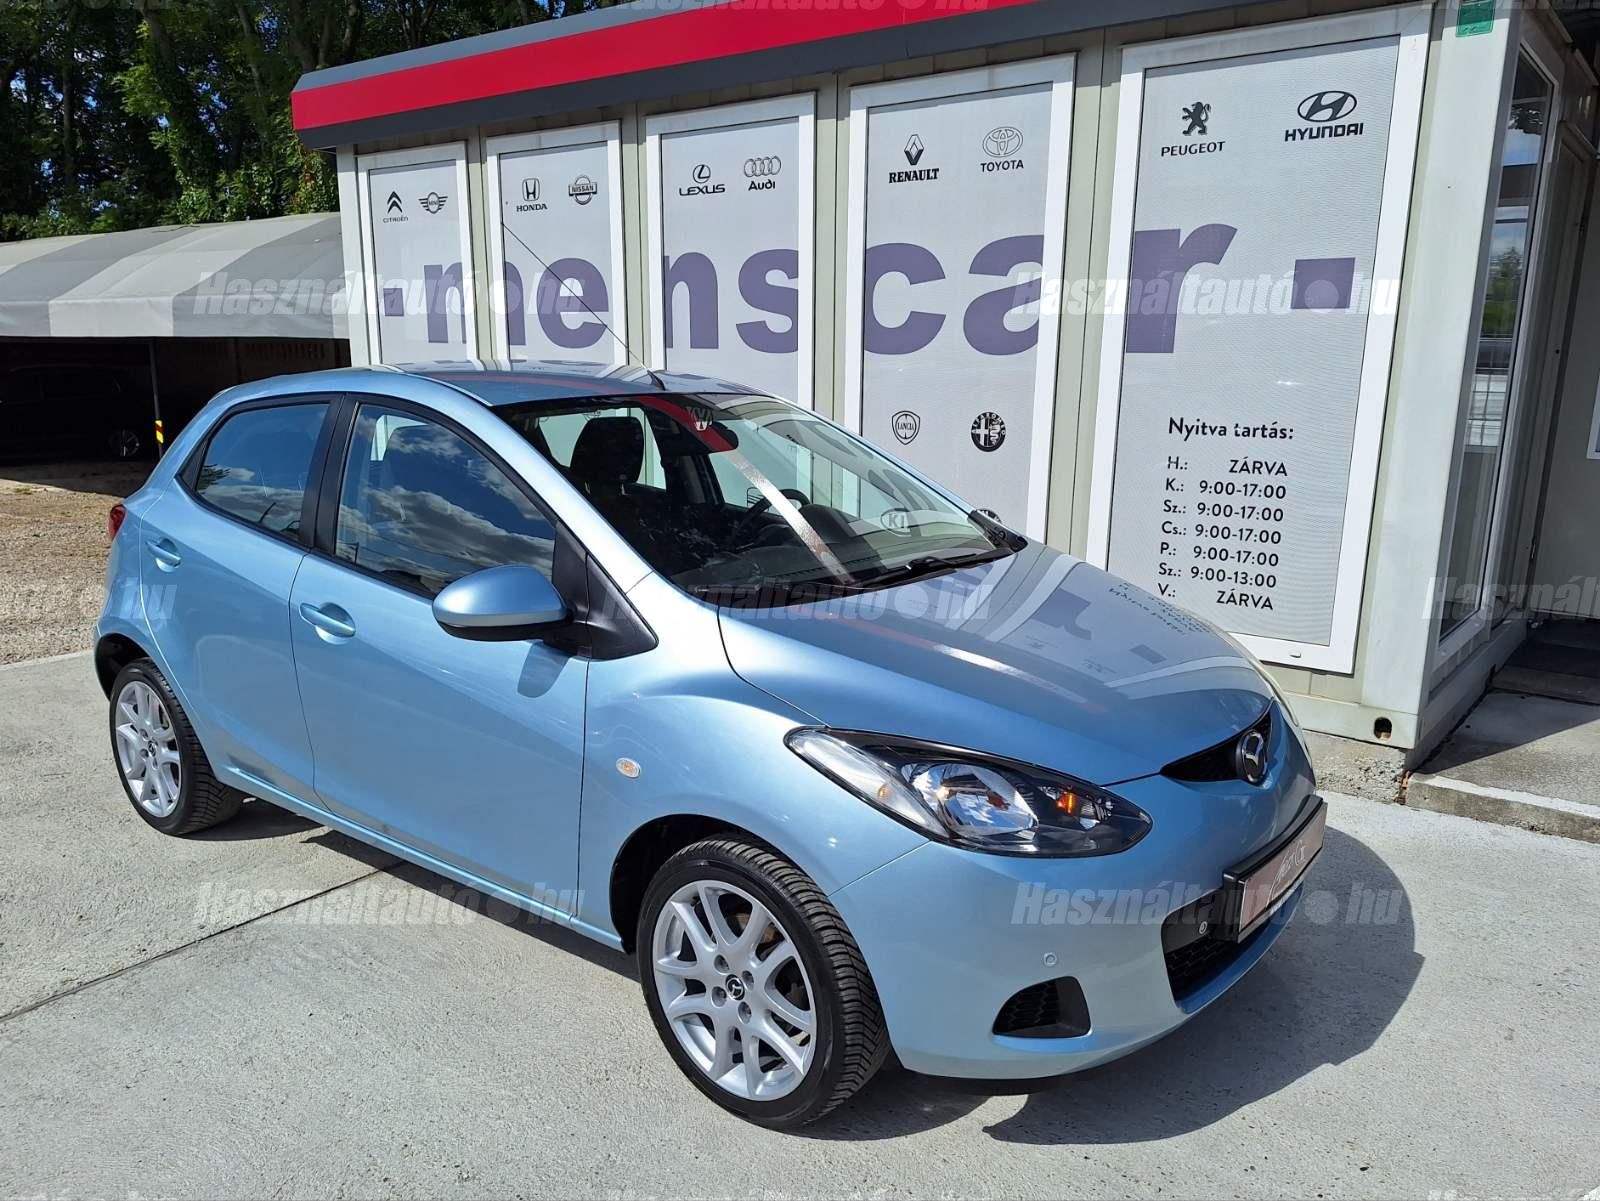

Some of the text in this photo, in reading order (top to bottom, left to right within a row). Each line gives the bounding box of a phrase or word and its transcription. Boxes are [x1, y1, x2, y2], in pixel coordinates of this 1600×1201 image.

[1284, 122, 1364, 142] HYUNDAI
[1161, 141, 1226, 157] PEUGEOT
[980, 159, 1024, 172] TOYOTA
[748, 179, 776, 191] Audi
[888, 168, 940, 184] RENAULT
[571, 185, 594, 193] NISSAN
[678, 184, 726, 196] LEXUS
[516, 203, 548, 213] HONDA
[897, 422, 915, 431] LANCIA
[1168, 417, 1294, 441] Nyitva tartás:
[1167, 456, 1288, 476] H.: ZÁRVA
[1165, 478, 1286, 499] K.: 9:00-17:00
[1163, 500, 1284, 522] Sz.: 9:00-17:00
[1161, 521, 1281, 544] Cs.: 9:00-17:00
[1160, 542, 1279, 567] P.: 9:00-17:00
[1158, 562, 1277, 588] Sz.: 9:00-13:00
[1157, 582, 1274, 610] V.: ZÁRVA
